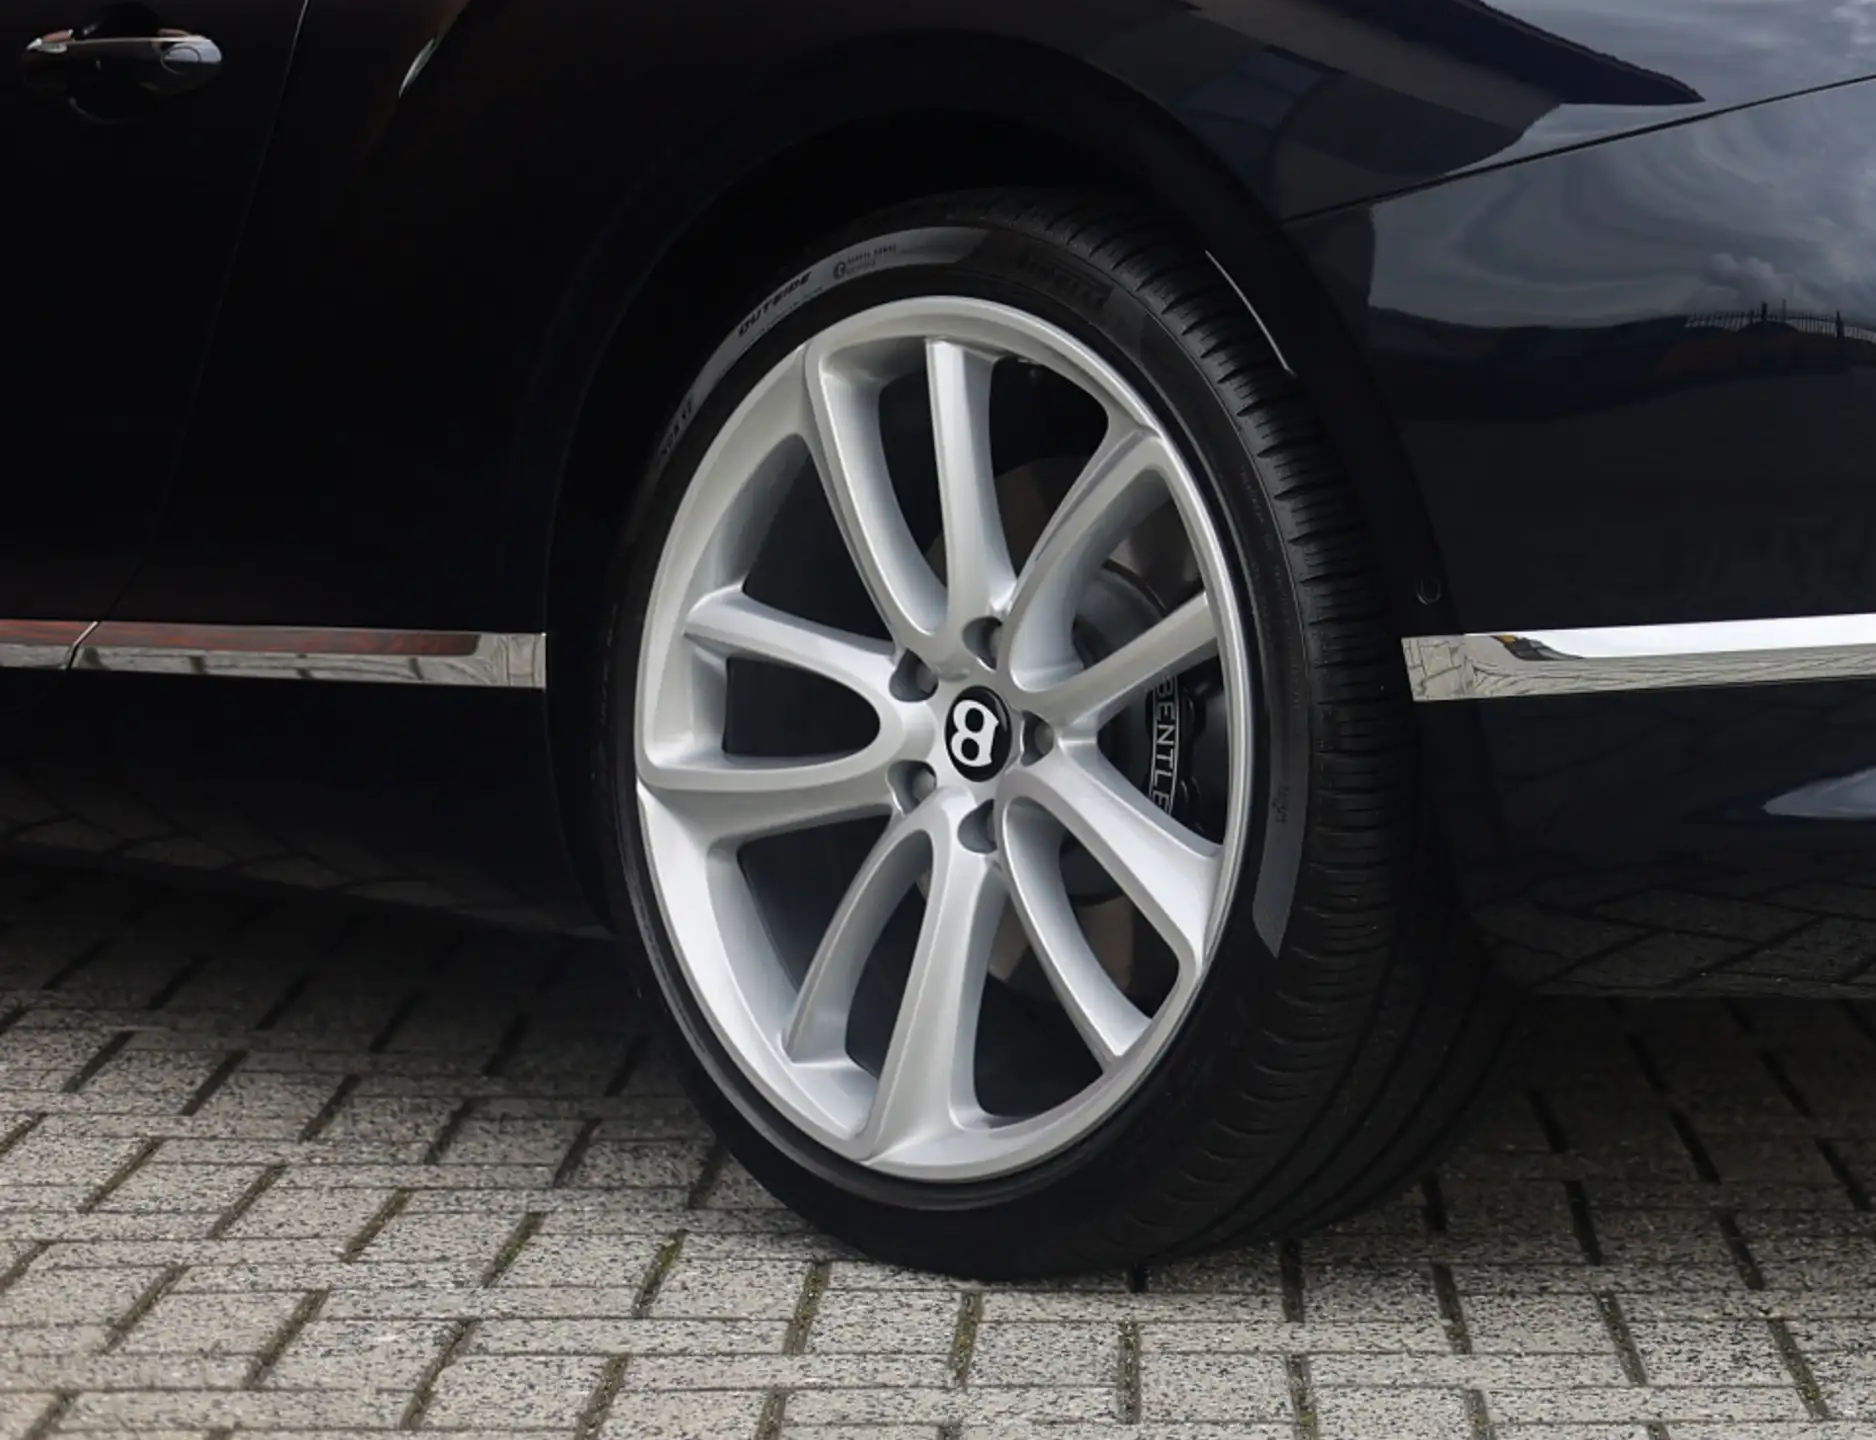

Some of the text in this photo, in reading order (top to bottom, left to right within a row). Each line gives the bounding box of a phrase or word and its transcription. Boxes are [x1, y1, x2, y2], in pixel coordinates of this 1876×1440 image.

[739, 271, 811, 337] OUTSIDE
[952, 700, 999, 767] B
[1153, 678, 1175, 814] BENTLE
